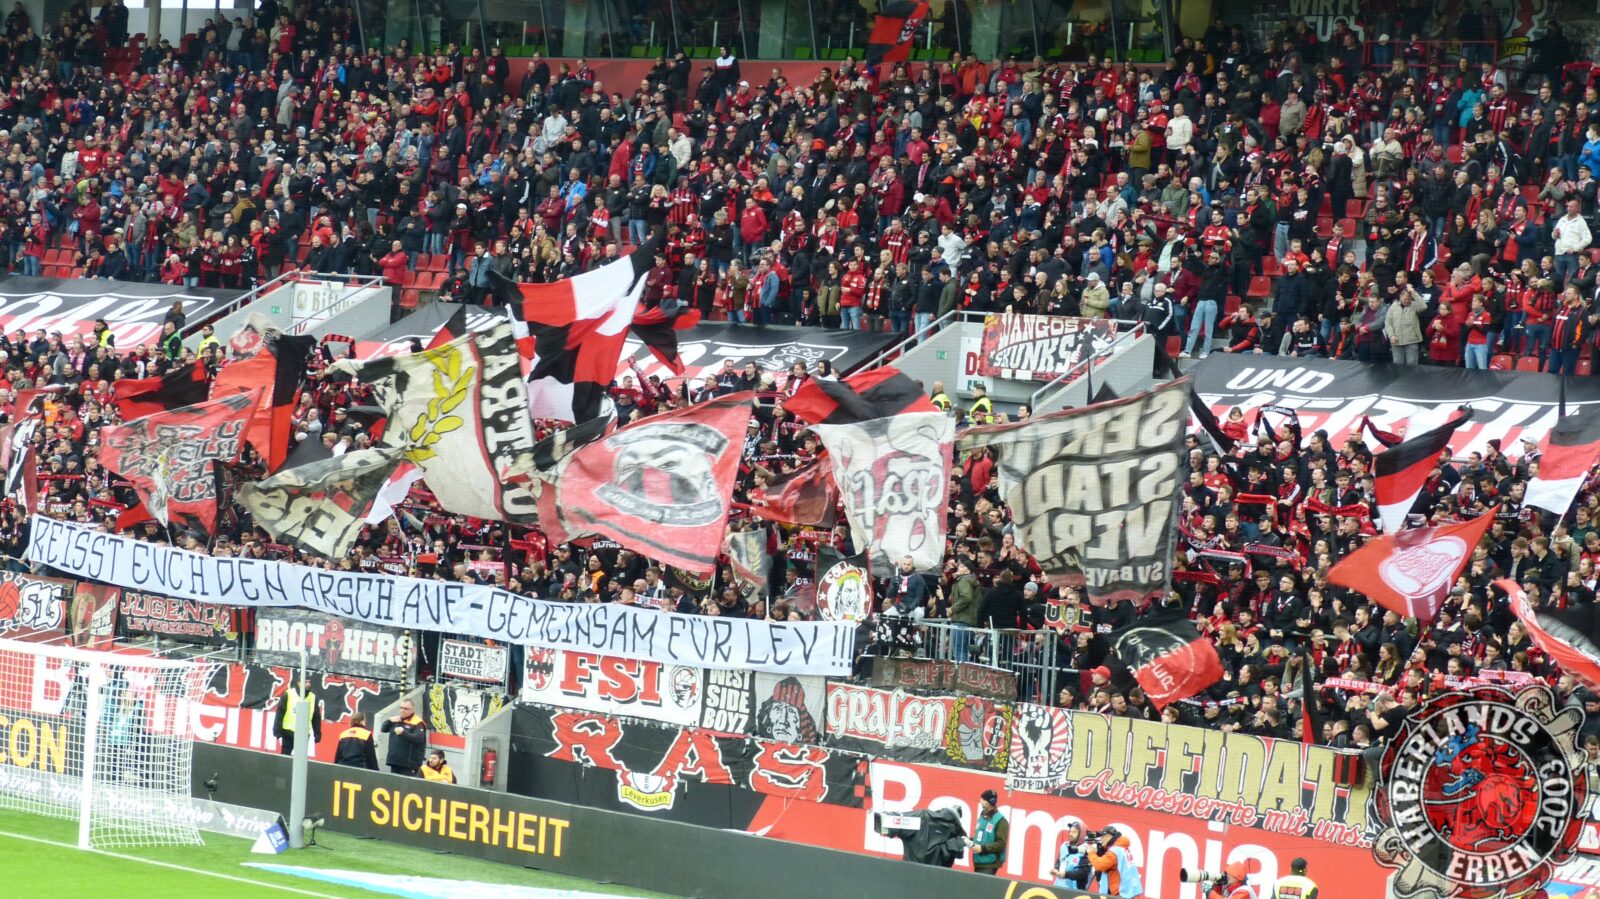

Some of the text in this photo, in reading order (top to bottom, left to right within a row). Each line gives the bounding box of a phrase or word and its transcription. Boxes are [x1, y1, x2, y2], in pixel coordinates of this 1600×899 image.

[1225, 367, 1336, 393] UND
[31, 518, 124, 582] REISST
[216, 559, 288, 601] DEN
[301, 571, 397, 620] ARSCH
[667, 616, 732, 663] FÜR
[745, 622, 818, 666] LEV
[120, 591, 218, 625] JUGEND
[443, 655, 483, 670] VERBOTE
[444, 643, 484, 660] STADT
[443, 664, 482, 677] AUFHEBEN
[559, 649, 664, 707] FSI
[705, 684, 751, 714] SIDE
[702, 706, 749, 735] BOYZ
[624, 787, 668, 805] Leverkusen
[1075, 768, 1257, 826] Ausgesperrte
[1265, 806, 1309, 837] mit
[332, 780, 570, 858] IT SICHERHEIT
